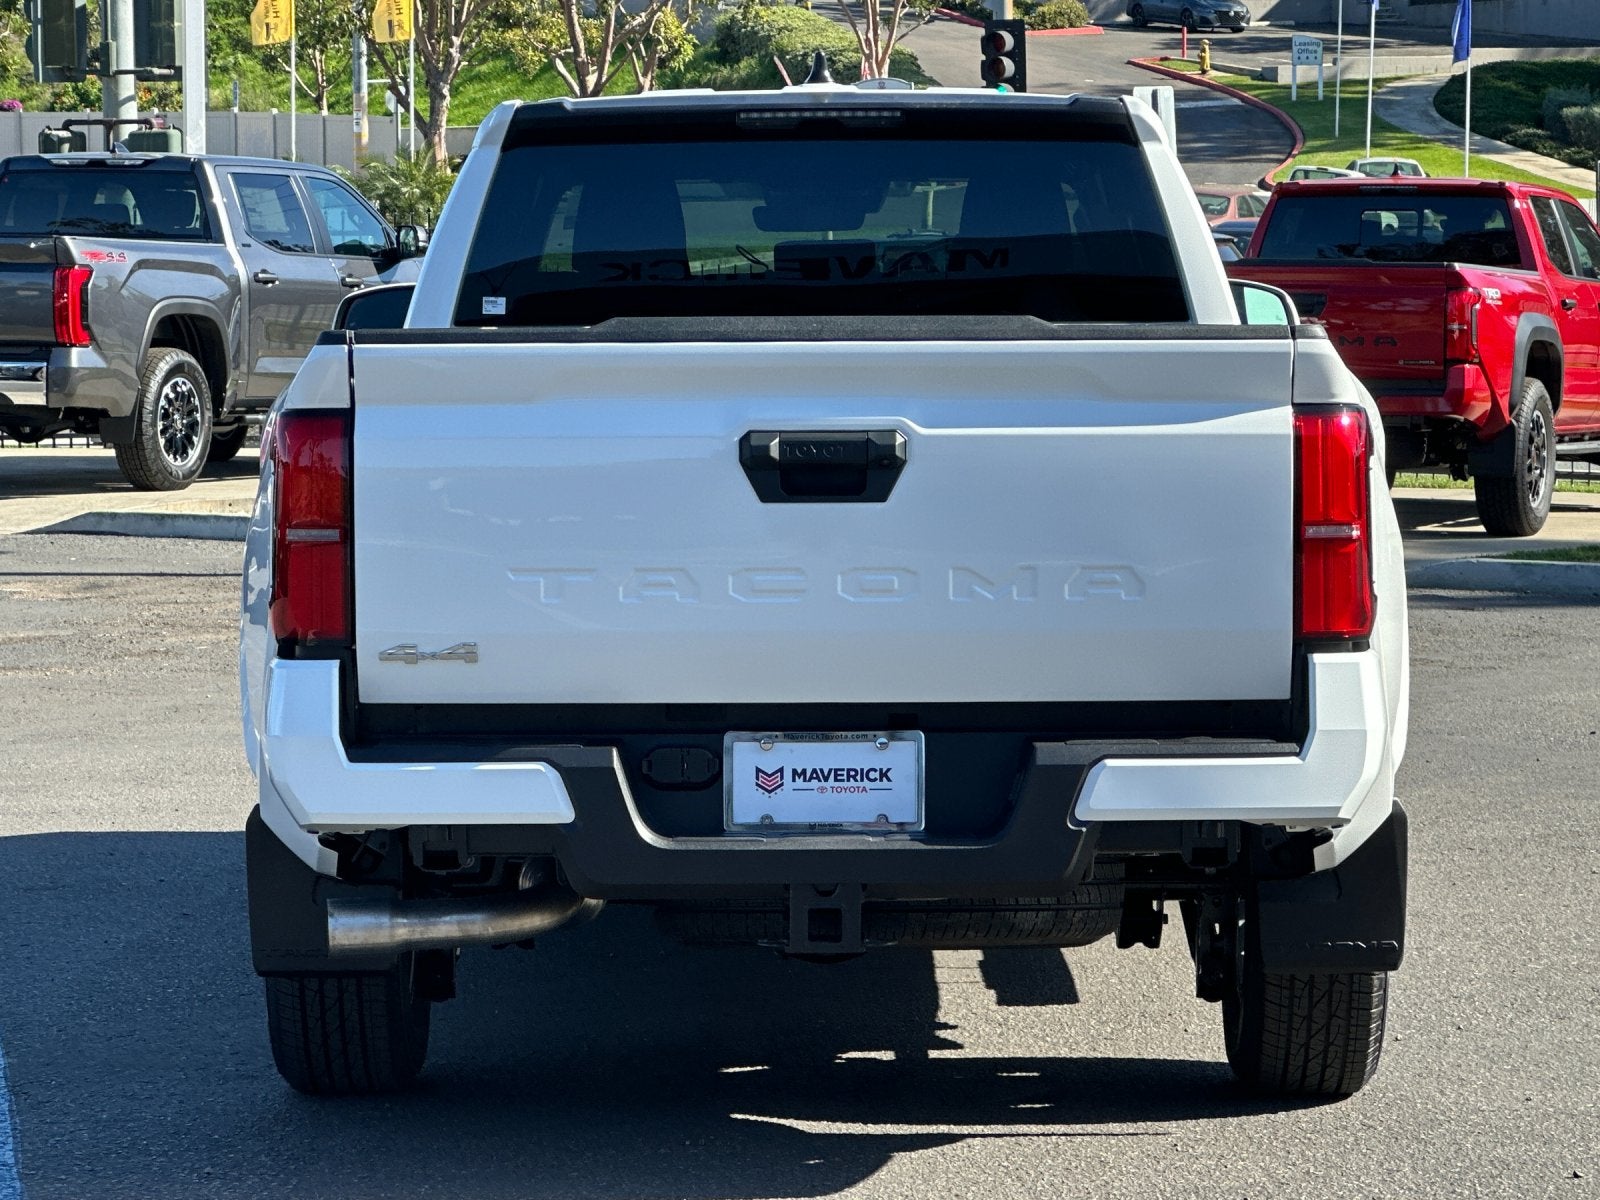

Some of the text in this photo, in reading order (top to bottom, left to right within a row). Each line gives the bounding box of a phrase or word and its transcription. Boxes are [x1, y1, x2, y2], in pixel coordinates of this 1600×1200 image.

[507, 566, 1146, 603] TACOMA
[783, 733, 869, 741] MaverickToyota.com
[791, 767, 893, 783] MAVERICK
[830, 786, 868, 794] TOYOTA
